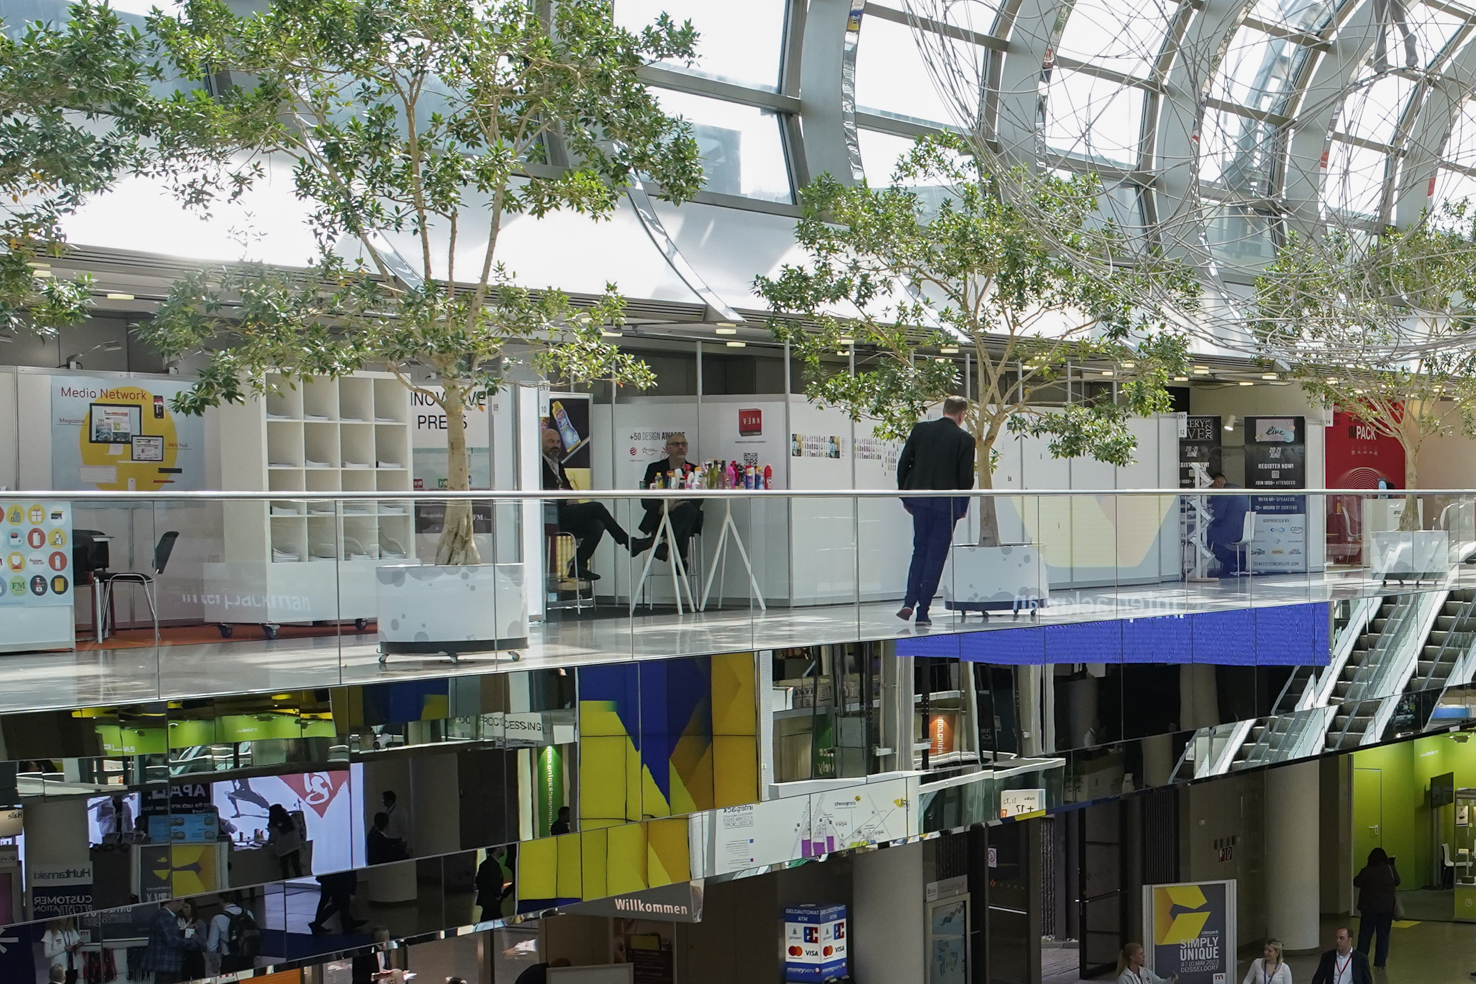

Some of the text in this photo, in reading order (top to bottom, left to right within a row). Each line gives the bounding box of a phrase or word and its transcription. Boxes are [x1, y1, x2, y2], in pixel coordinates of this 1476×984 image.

[61, 387, 147, 401] Media Network
[411, 391, 486, 406] INOVVE
[59, 417, 85, 425] Magazine
[418, 415, 468, 429] PRES
[642, 432, 661, 441] DESIGN
[1266, 425, 1285, 436] live
[615, 898, 688, 915] Willkommen
[835, 945, 845, 953] VISA
[1180, 937, 1219, 949] SIMPLY
[1180, 947, 1219, 961] UNIQUE
[822, 965, 842, 973] moneyserv
